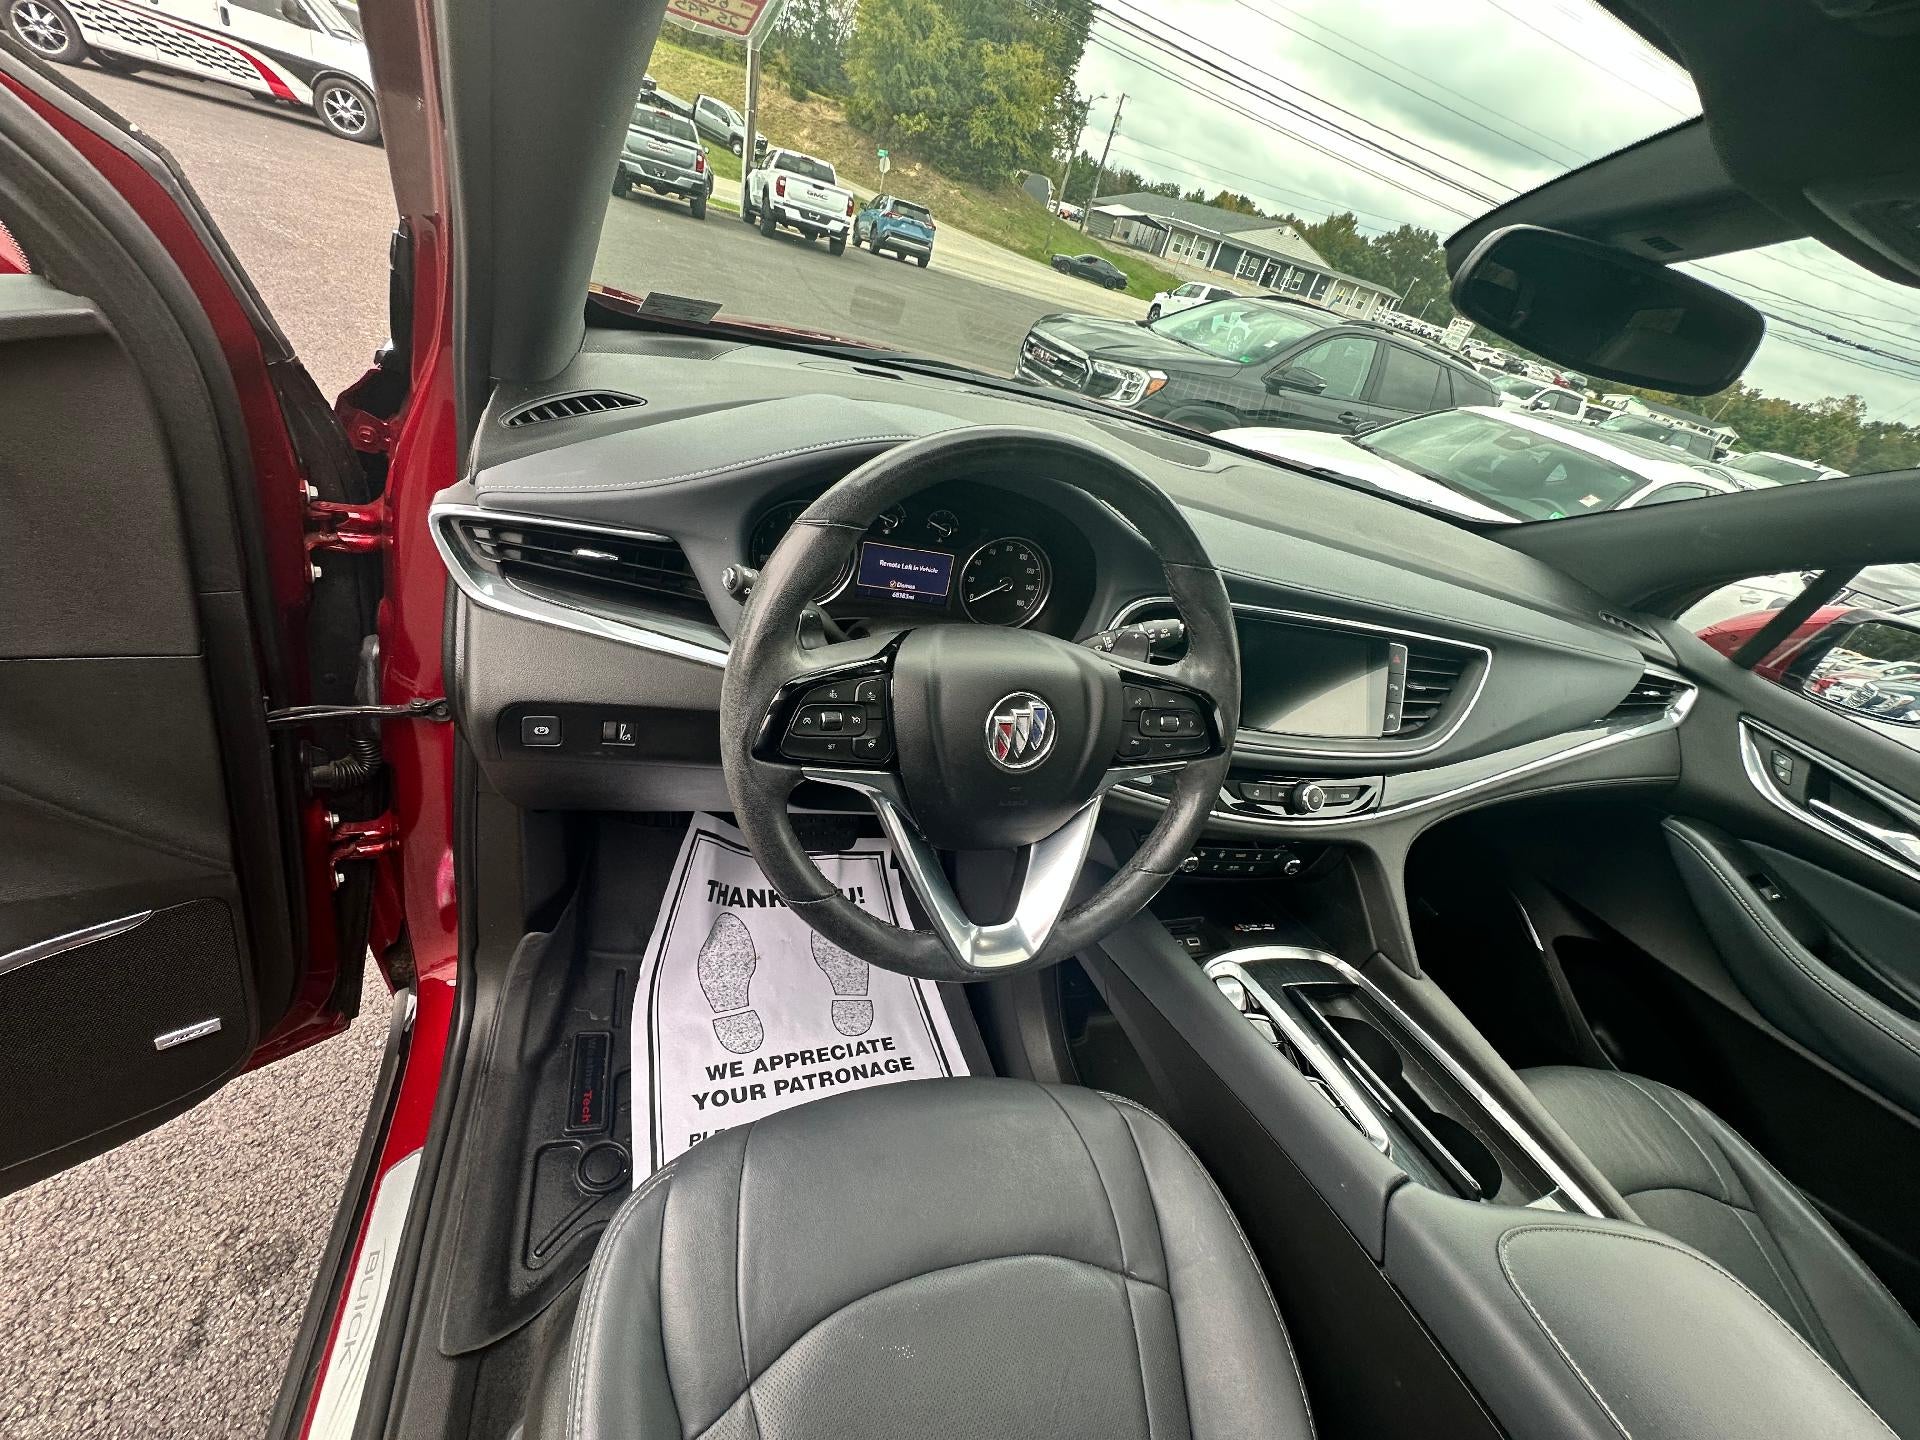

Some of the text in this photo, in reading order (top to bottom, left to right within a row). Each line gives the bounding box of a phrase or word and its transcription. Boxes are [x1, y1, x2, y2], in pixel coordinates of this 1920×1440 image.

[880, 560, 901, 569] Remote
[902, 563, 912, 571] Left
[920, 566, 938, 574] Vehicle
[691, 1056, 915, 1111] YOUR PATRONAGE
[705, 1036, 896, 1082] WE APPRECIATE
[338, 1250, 381, 1368] BUICK
